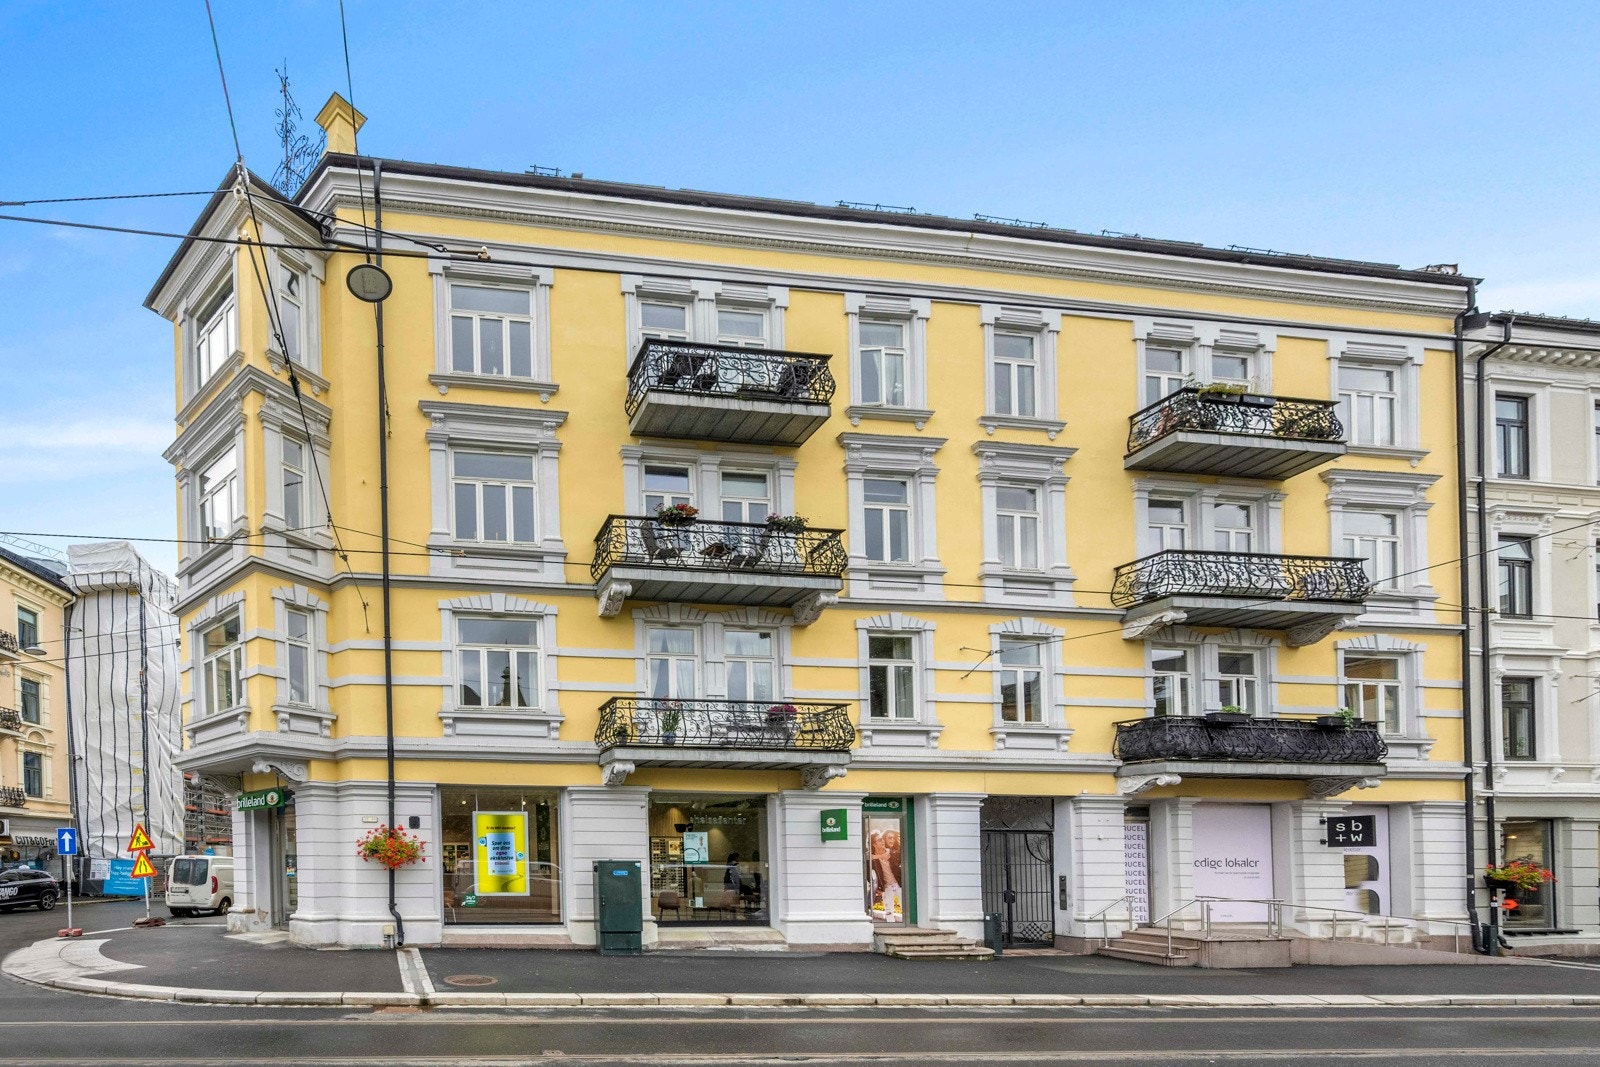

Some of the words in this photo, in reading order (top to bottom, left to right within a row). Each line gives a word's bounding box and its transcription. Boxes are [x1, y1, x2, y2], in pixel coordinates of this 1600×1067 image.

[237, 795, 265, 808] brilleland
[1193, 857, 1223, 870] edige
[1225, 857, 1260, 868] lokaler
